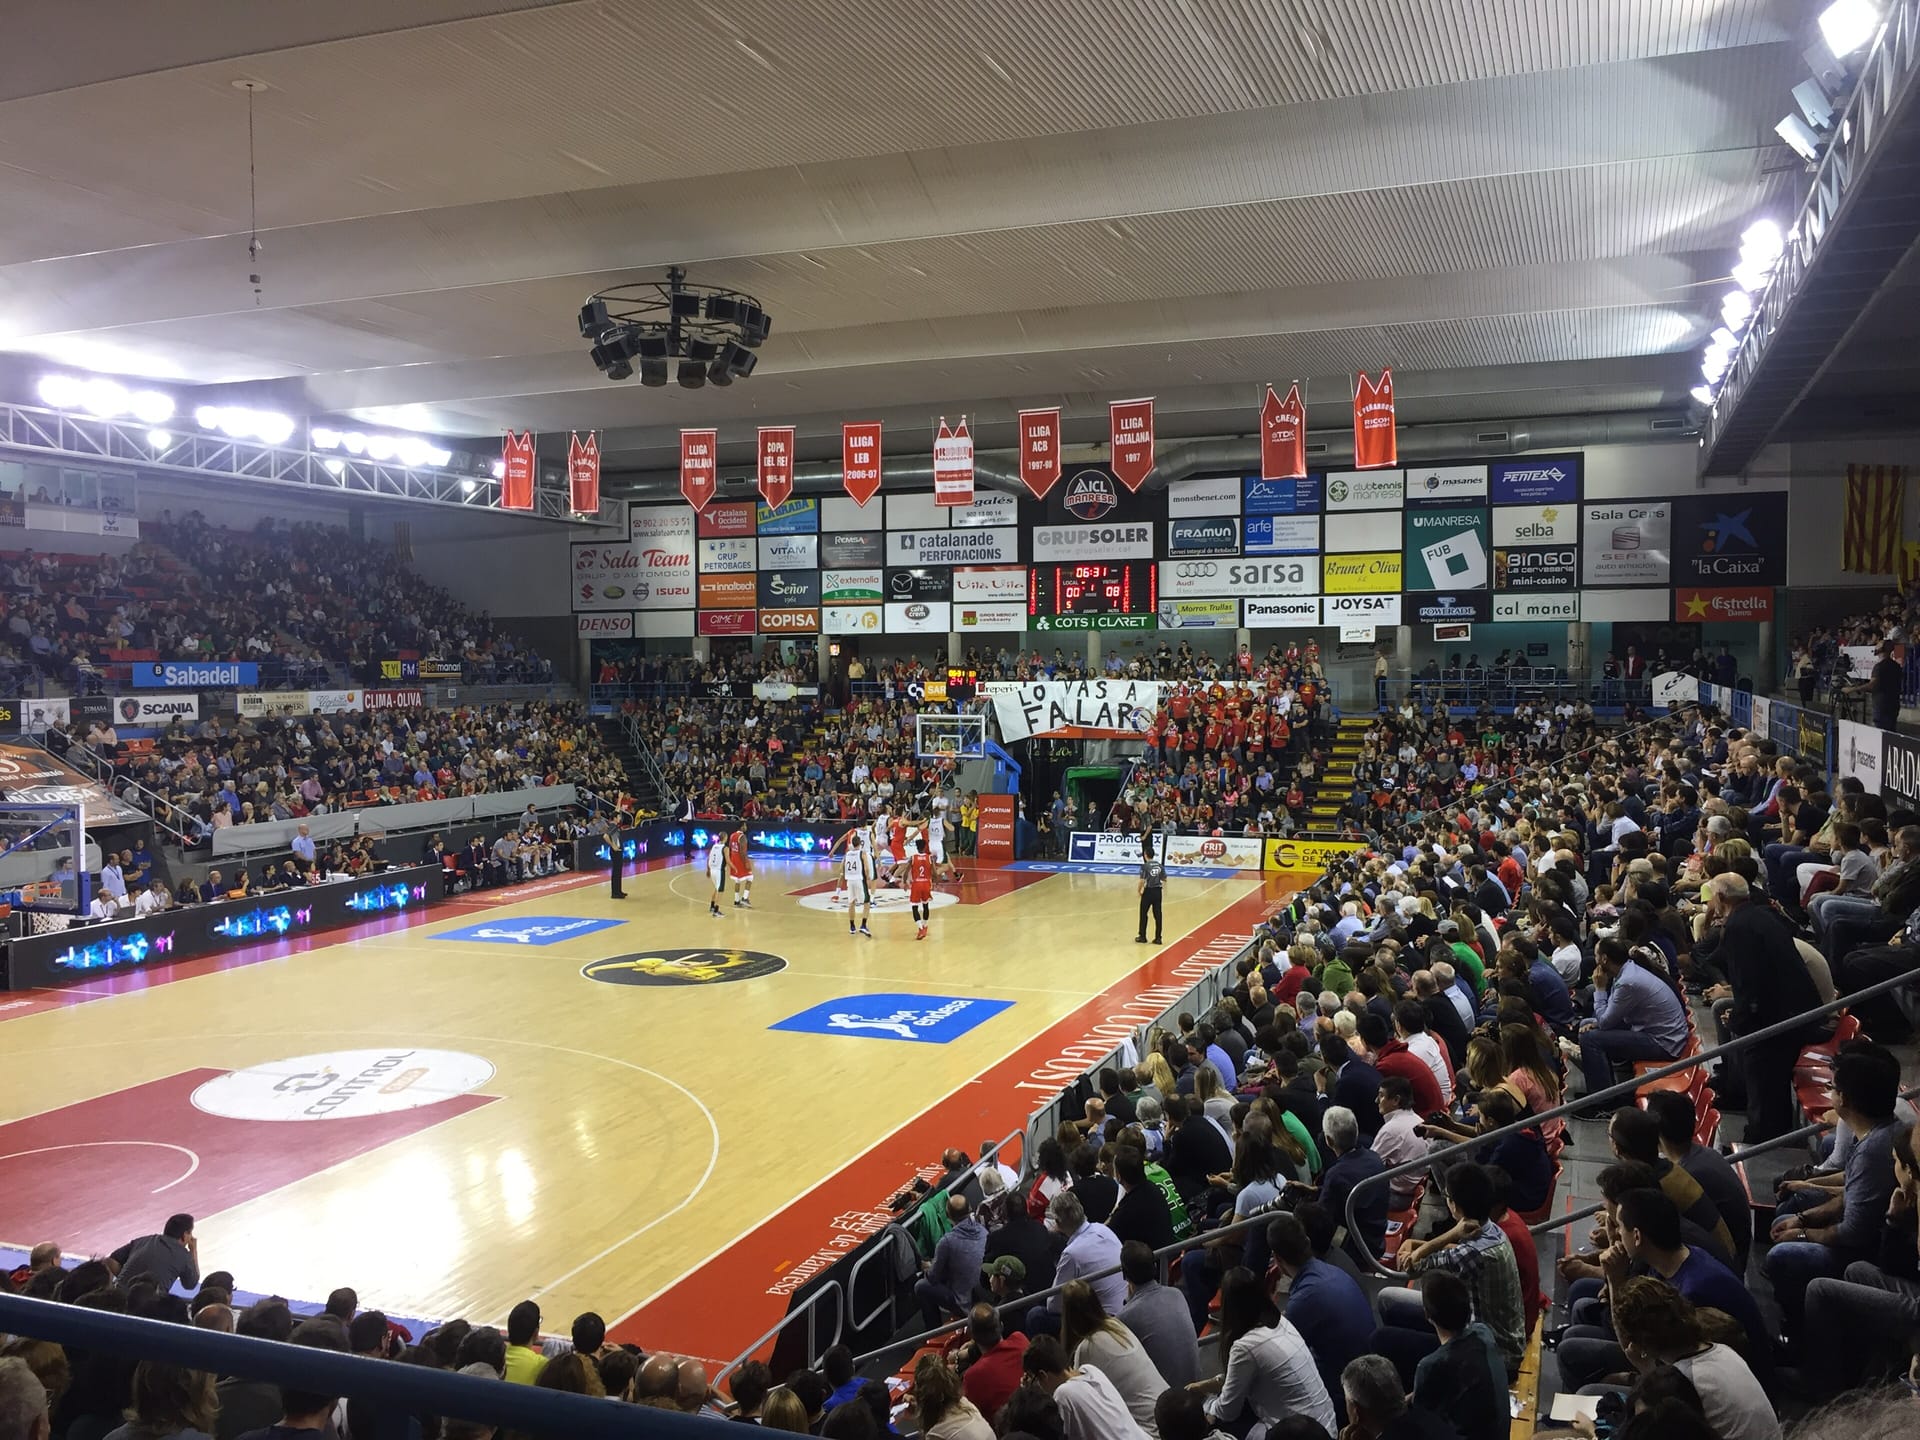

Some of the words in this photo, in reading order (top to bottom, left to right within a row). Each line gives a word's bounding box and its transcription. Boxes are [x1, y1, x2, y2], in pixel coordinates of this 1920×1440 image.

[1290, 401, 1296, 410] 7
[1121, 417, 1144, 430] LLIGA
[1275, 414, 1300, 425] CREUS
[1364, 417, 1390, 426] RICOH
[1029, 426, 1051, 438] LLIGA
[1277, 430, 1295, 438] TDK
[849, 436, 874, 447] LLIGA
[1115, 432, 1150, 446] CATALANA
[689, 445, 708, 455] LLIGA
[767, 442, 785, 453] COPA
[1032, 441, 1048, 452] ACB
[684, 458, 713, 469] CATALANA
[764, 456, 775, 467] DEL
[777, 456, 788, 467] REI
[854, 453, 870, 464] LEB
[1125, 453, 1141, 463] 1997
[1502, 470, 1550, 482] PENTEX
[1353, 489, 1402, 499] manresa
[1066, 494, 1115, 507] MANRESA
[718, 509, 748, 517] Catalana
[1591, 510, 1624, 520] Sala
[1628, 509, 1665, 519] Cars
[643, 519, 657, 527] 902
[718, 517, 748, 525] Occident
[1247, 520, 1272, 533] arfe
[1413, 515, 1481, 528] UMANRESA
[1175, 527, 1232, 538] FRAMUN
[1515, 523, 1554, 538] selba
[919, 532, 994, 549] catalanade
[770, 546, 807, 555] VITAM
[919, 547, 1002, 562] PERFORACIONS
[1426, 544, 1452, 561] FUB
[600, 550, 640, 569] Sala
[642, 549, 691, 567] Team
[717, 553, 738, 561] GRUP
[704, 561, 752, 570] PETROBAGES
[1326, 561, 1366, 576] Brunet
[1369, 560, 1400, 575] Oliva
[1076, 567, 1108, 578] 06:31
[1230, 563, 1304, 585] sarsa
[840, 575, 880, 585] externalia
[1512, 576, 1568, 586] mini-casino
[656, 587, 690, 596] ISUZU
[770, 579, 809, 595] Señor
[1066, 587, 1080, 598] 00
[1105, 586, 1120, 597] 08
[1181, 605, 1207, 613] Morros
[1209, 603, 1233, 612] Trullas
[1248, 602, 1315, 614] Panasonic
[1332, 598, 1394, 610] JOYSAT
[1496, 601, 1519, 616] cal
[1527, 600, 1576, 615] manel
[1711, 596, 1768, 610] Estrella
[1420, 607, 1475, 616] POWERADE
[1727, 609, 1752, 617] Damm
[580, 617, 631, 631] DENSO
[761, 613, 816, 628] COPISA
[1055, 617, 1089, 628] COTS
[1097, 616, 1148, 628] CLARET
[165, 665, 239, 686] Sabadell
[949, 677, 963, 686] 24
[1018, 684, 1046, 707] LO
[1064, 680, 1108, 700] VAS
[1125, 682, 1137, 702] A
[143, 702, 194, 715] SCANIA
[1023, 699, 1134, 734] FALAR
[1203, 843, 1223, 851] FRIT
[846, 861, 857, 871] 24
[919, 866, 925, 877] 2
[912, 999, 975, 1027] endesa
[303, 1050, 417, 1116] CONTROL
[828, 1233, 864, 1248] de
[765, 1247, 847, 1296] Manresa
